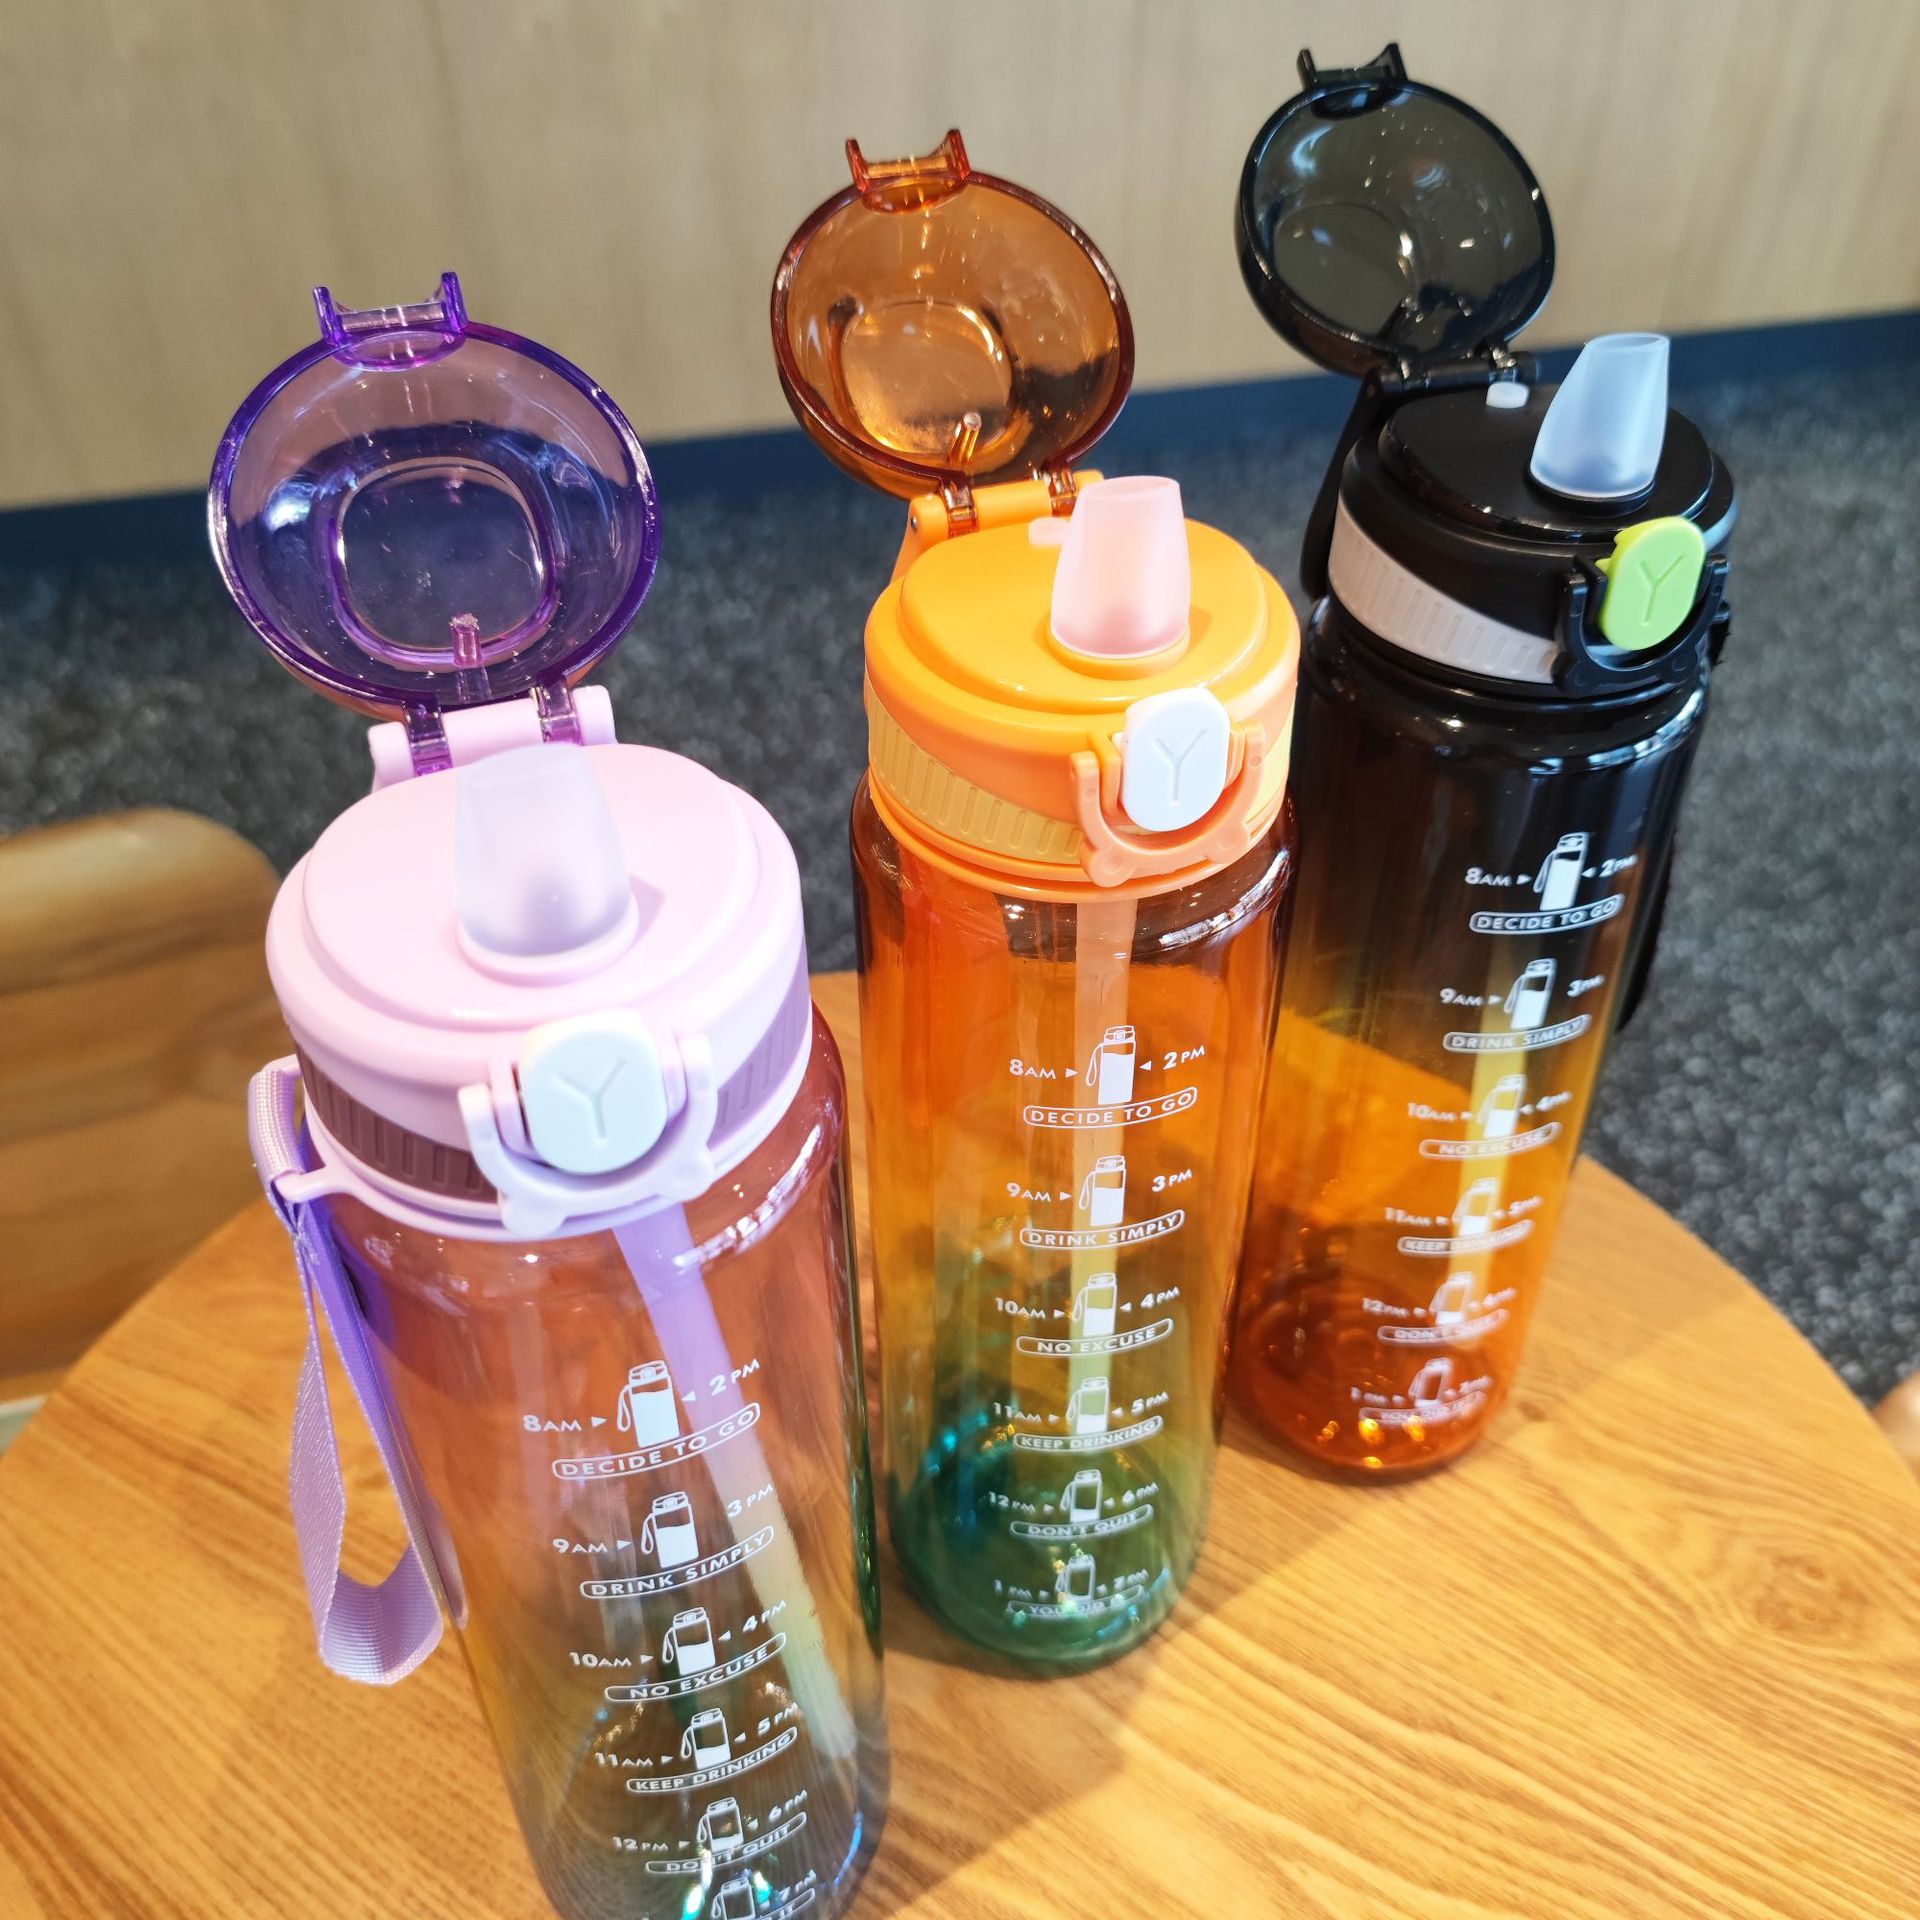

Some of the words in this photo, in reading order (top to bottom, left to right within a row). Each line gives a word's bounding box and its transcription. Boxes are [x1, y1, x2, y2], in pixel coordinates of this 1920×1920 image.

[1465, 866, 1512, 887] 8AM
[1475, 914, 1551, 931] DECIDE
[1559, 910, 1586, 926] TO
[1590, 900, 1617, 918] GO
[1439, 987, 1483, 1007] 9AM
[1450, 1036, 1515, 1048] DRINK
[1522, 1017, 1584, 1046] SIMPLY
[1009, 1058, 1057, 1080] 8AM
[1162, 1045, 1206, 1071] 2PM
[1030, 1109, 1115, 1125] DECIDE
[1123, 1105, 1152, 1121] TO
[1160, 1091, 1193, 1112] GO
[1006, 1182, 1052, 1203] 9AM
[1151, 1168, 1193, 1193] 3PM
[1027, 1231, 1097, 1247] DRINK
[1107, 1214, 1178, 1243] SIMPLY
[995, 1297, 1047, 1319] 10AM
[1140, 1286, 1181, 1310] 4PM
[1036, 1341, 1072, 1354] NO
[1080, 1326, 1157, 1354] EXCUSE
[709, 1358, 761, 1397] 2PM
[522, 1414, 583, 1433] 8AM
[992, 1402, 1042, 1423] 11AM
[561, 1451, 662, 1476] DECIDE
[673, 1434, 708, 1455] TO
[718, 1408, 757, 1435] GO
[1020, 1436, 1064, 1448] KEEP
[1070, 1418, 1160, 1449] DRINKING
[726, 1483, 775, 1519] 3PM
[988, 1490, 1037, 1514] 12PM
[1027, 1525, 1089, 1537] DON'T
[1094, 1511, 1138, 1531] QUIT
[552, 1538, 609, 1554] 9AM
[590, 1573, 674, 1596] DRINK
[685, 1534, 767, 1581] SIMPLY
[742, 1599, 787, 1633] 4PM
[569, 1651, 632, 1668] 10AM
[629, 1685, 670, 1700] NO
[680, 1645, 769, 1693] EXCUSE
[757, 1701, 800, 1737] 5PM
[594, 1752, 654, 1768] 11AM
[635, 1777, 685, 1791] KEEP
[692, 1733, 792, 1784] DRINKING
[612, 1835, 669, 1851] 12PM
[743, 1823, 792, 1856] QUIT
